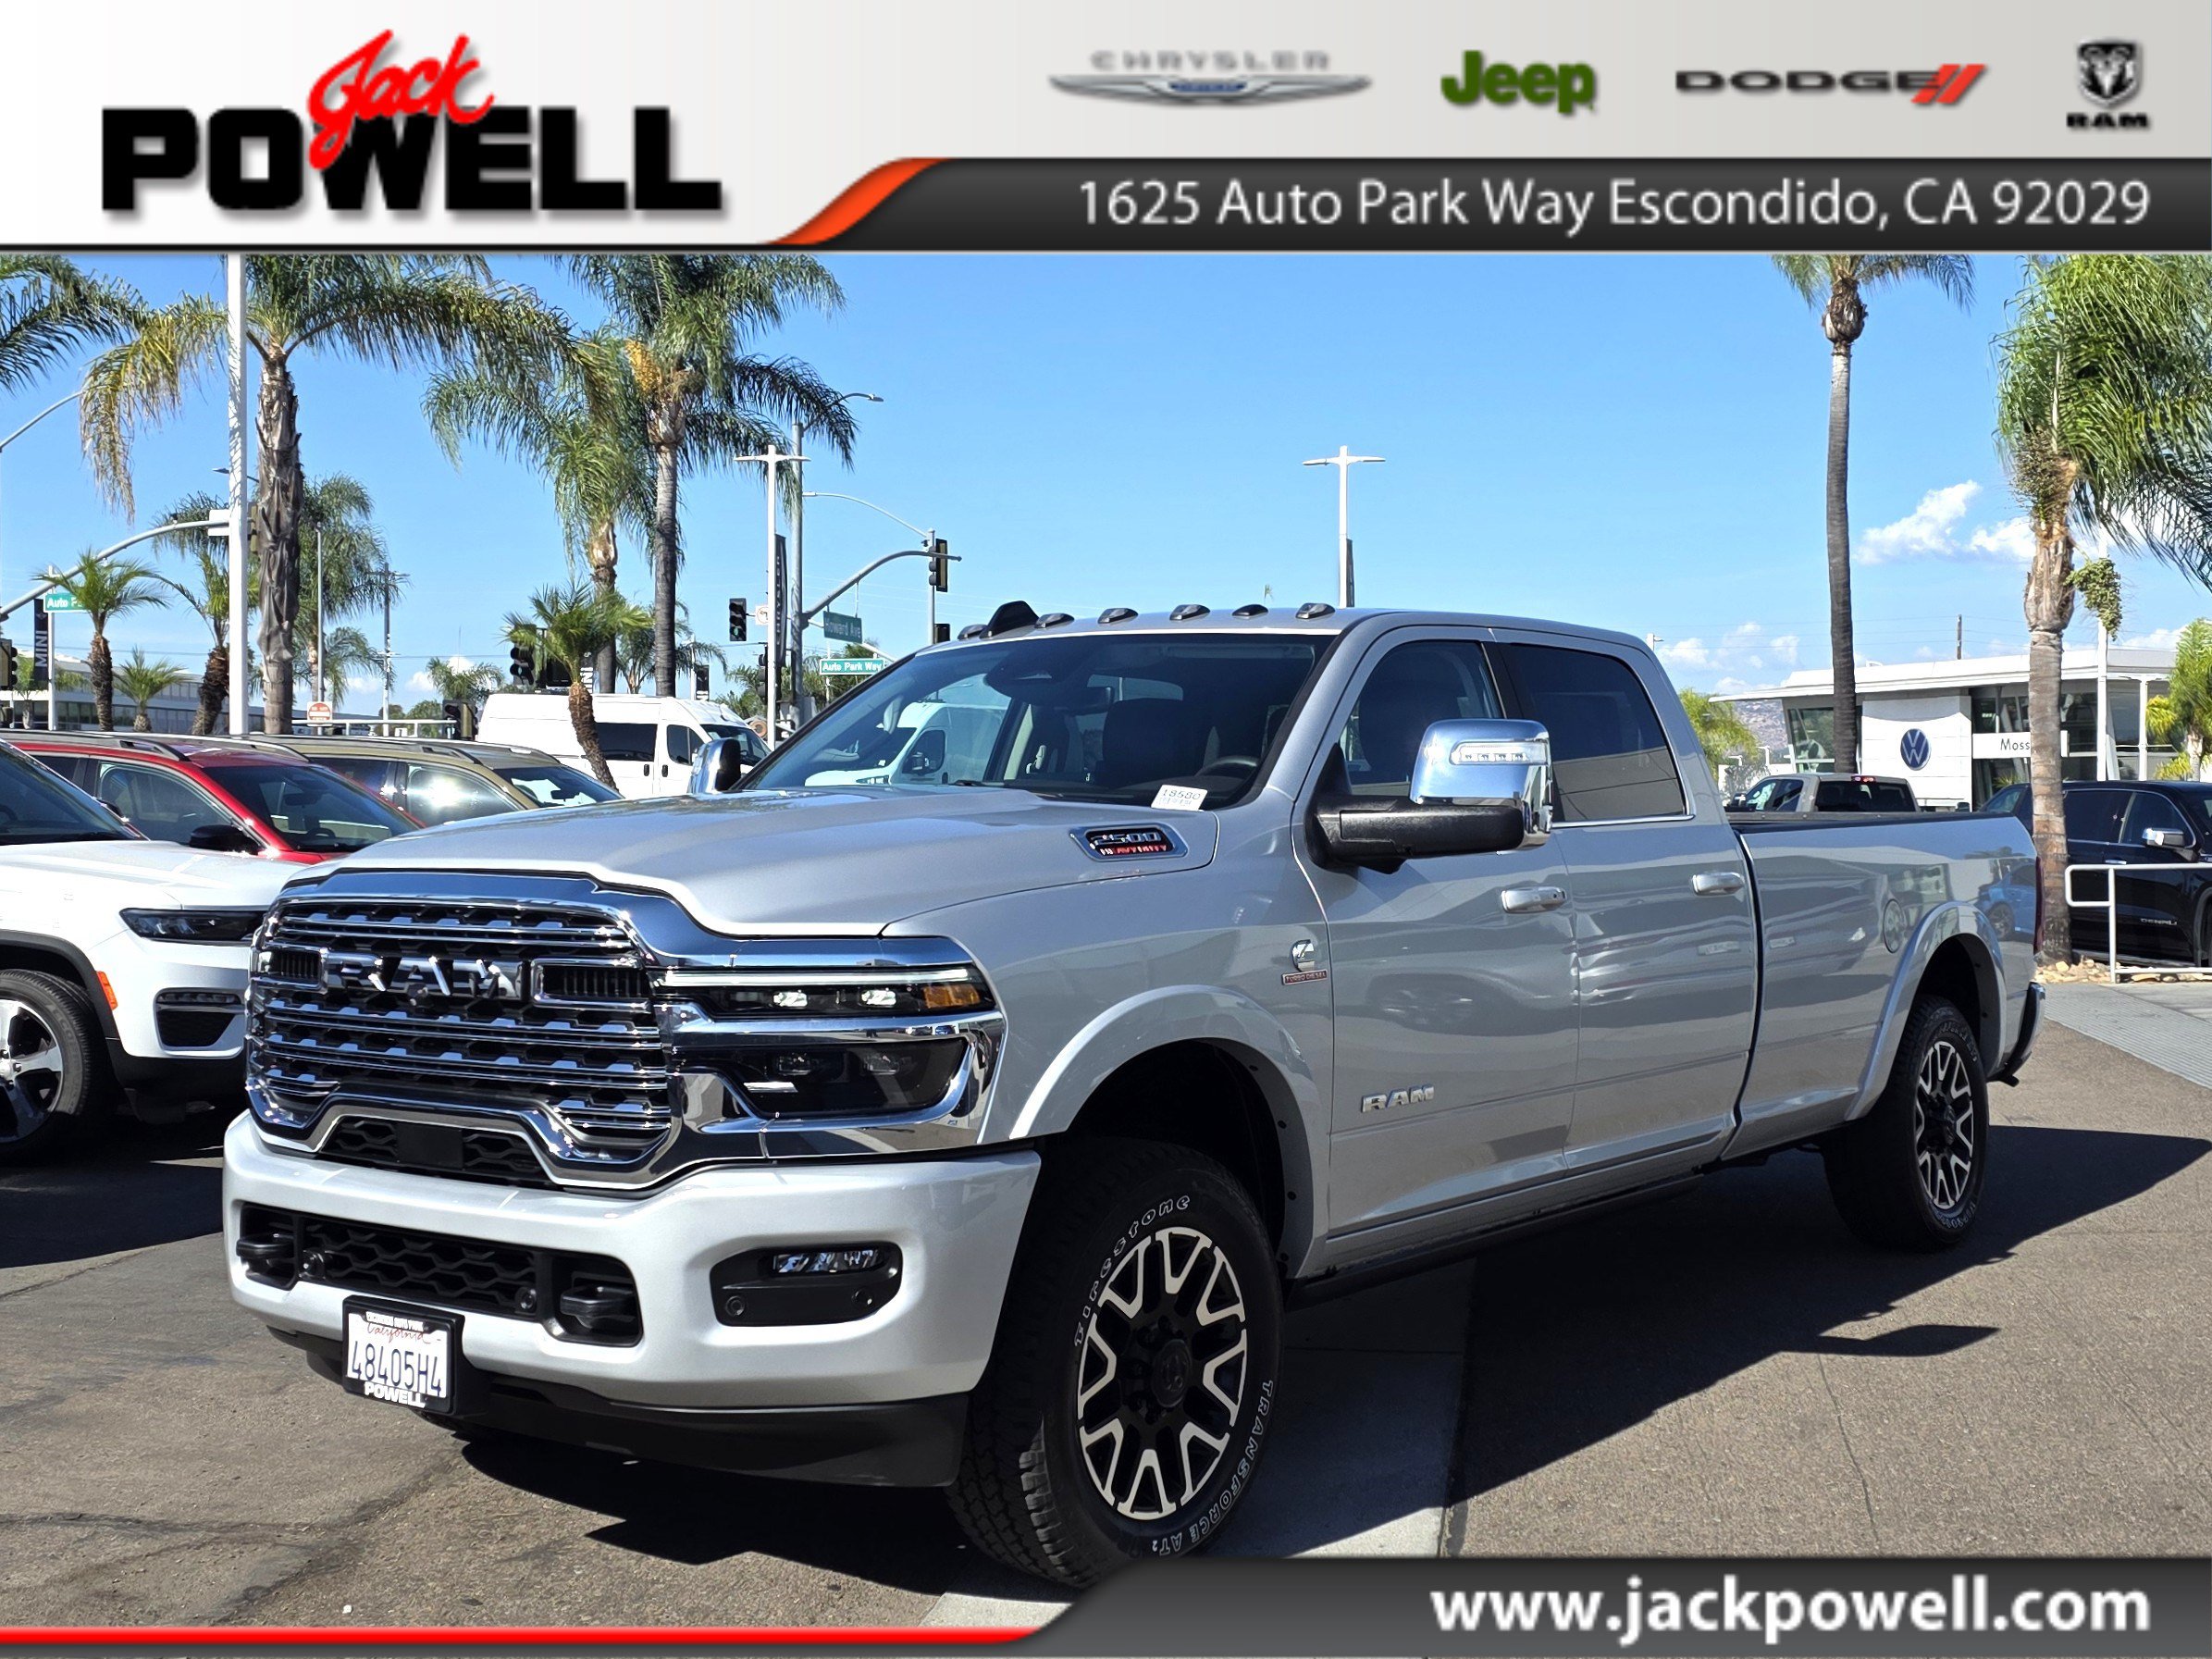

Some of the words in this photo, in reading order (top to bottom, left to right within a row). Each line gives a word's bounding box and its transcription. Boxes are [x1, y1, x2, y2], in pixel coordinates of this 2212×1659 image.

[46, 597, 68, 609] Auto
[35, 631, 47, 667] MINI
[822, 662, 842, 672] Auto
[844, 662, 863, 672] Park
[865, 662, 883, 674] Way
[1090, 832, 1162, 847] 2500
[323, 951, 523, 1000] RAM
[1361, 1083, 1435, 1113] RAM
[351, 1341, 442, 1396] 48405H4
[364, 1380, 426, 1409] POWELL
[1190, 1380, 1274, 1543] TRANSFORCE
